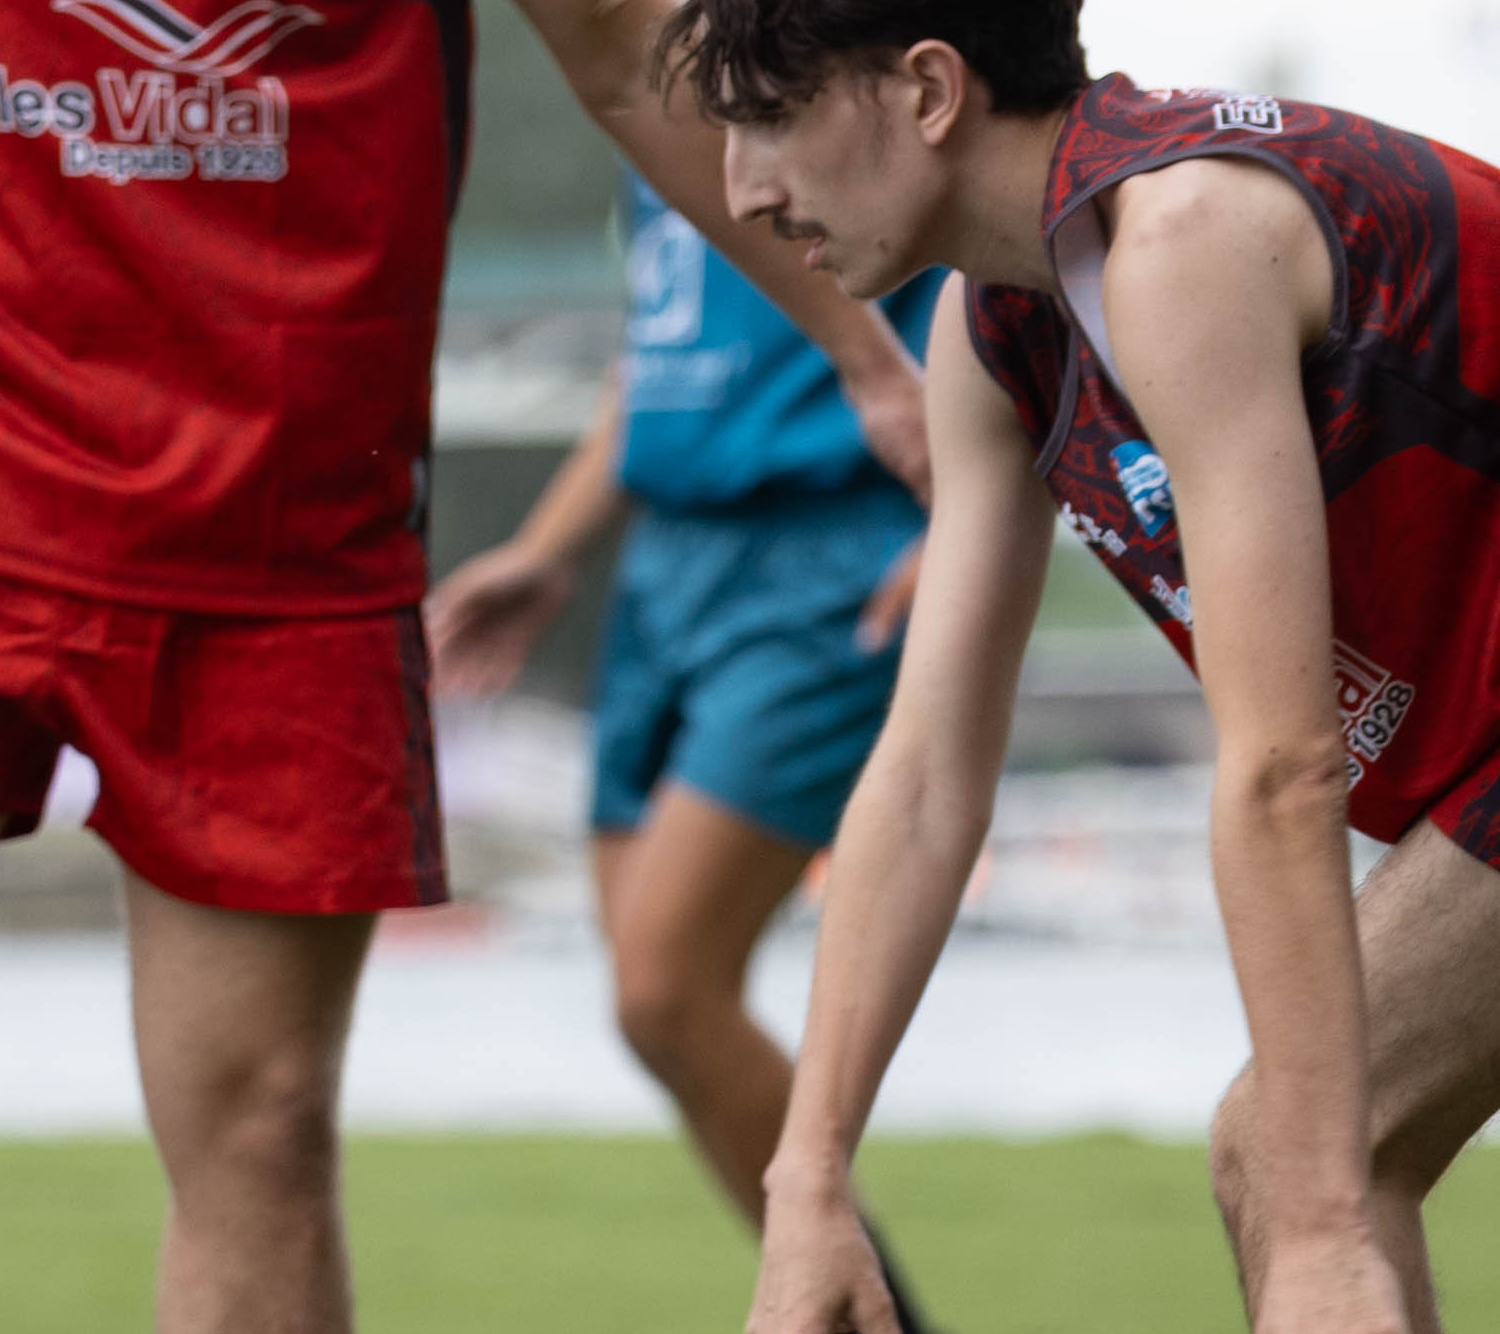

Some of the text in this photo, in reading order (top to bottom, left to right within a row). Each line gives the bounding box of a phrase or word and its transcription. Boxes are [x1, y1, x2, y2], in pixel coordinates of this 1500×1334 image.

[97, 68, 288, 143] Vidal
[61, 135, 192, 184] Depuis
[1352, 682, 1414, 760] 1928
